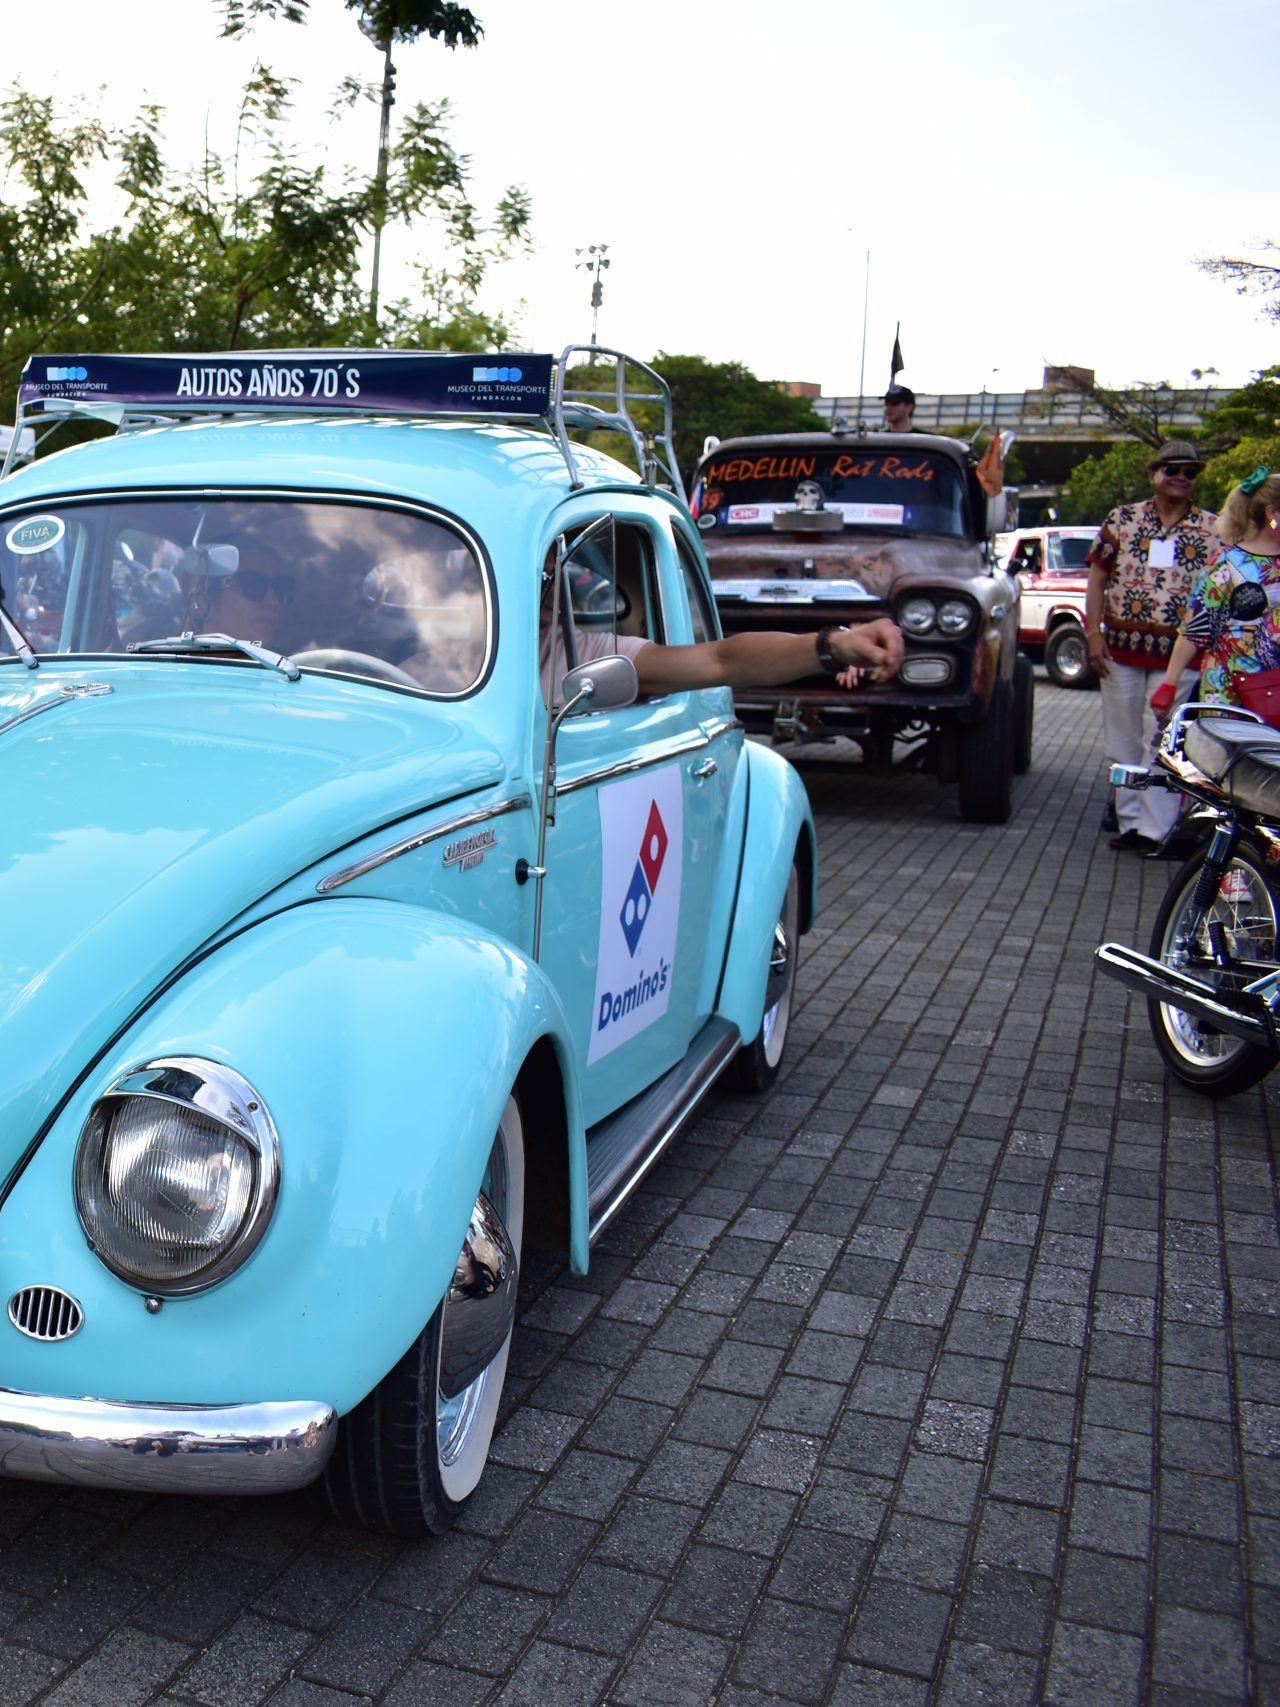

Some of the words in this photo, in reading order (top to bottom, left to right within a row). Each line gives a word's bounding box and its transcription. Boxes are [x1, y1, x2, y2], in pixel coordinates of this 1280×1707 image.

[25, 383, 51, 391] MUSEO
[51, 383, 64, 391] DEL
[65, 382, 109, 391] TRANSPORTE
[176, 367, 243, 397] AUTOS
[246, 364, 305, 397] AÑOS
[447, 384, 476, 393] MUSEO
[477, 385, 493, 393] DEL
[494, 384, 547, 395] TRANSPORTE
[708, 456, 817, 485] MEDELLIN
[831, 454, 876, 478] Rat
[879, 455, 936, 482] Rods
[20, 526, 50, 541] FIVA
[597, 956, 669, 1033] Domino's
